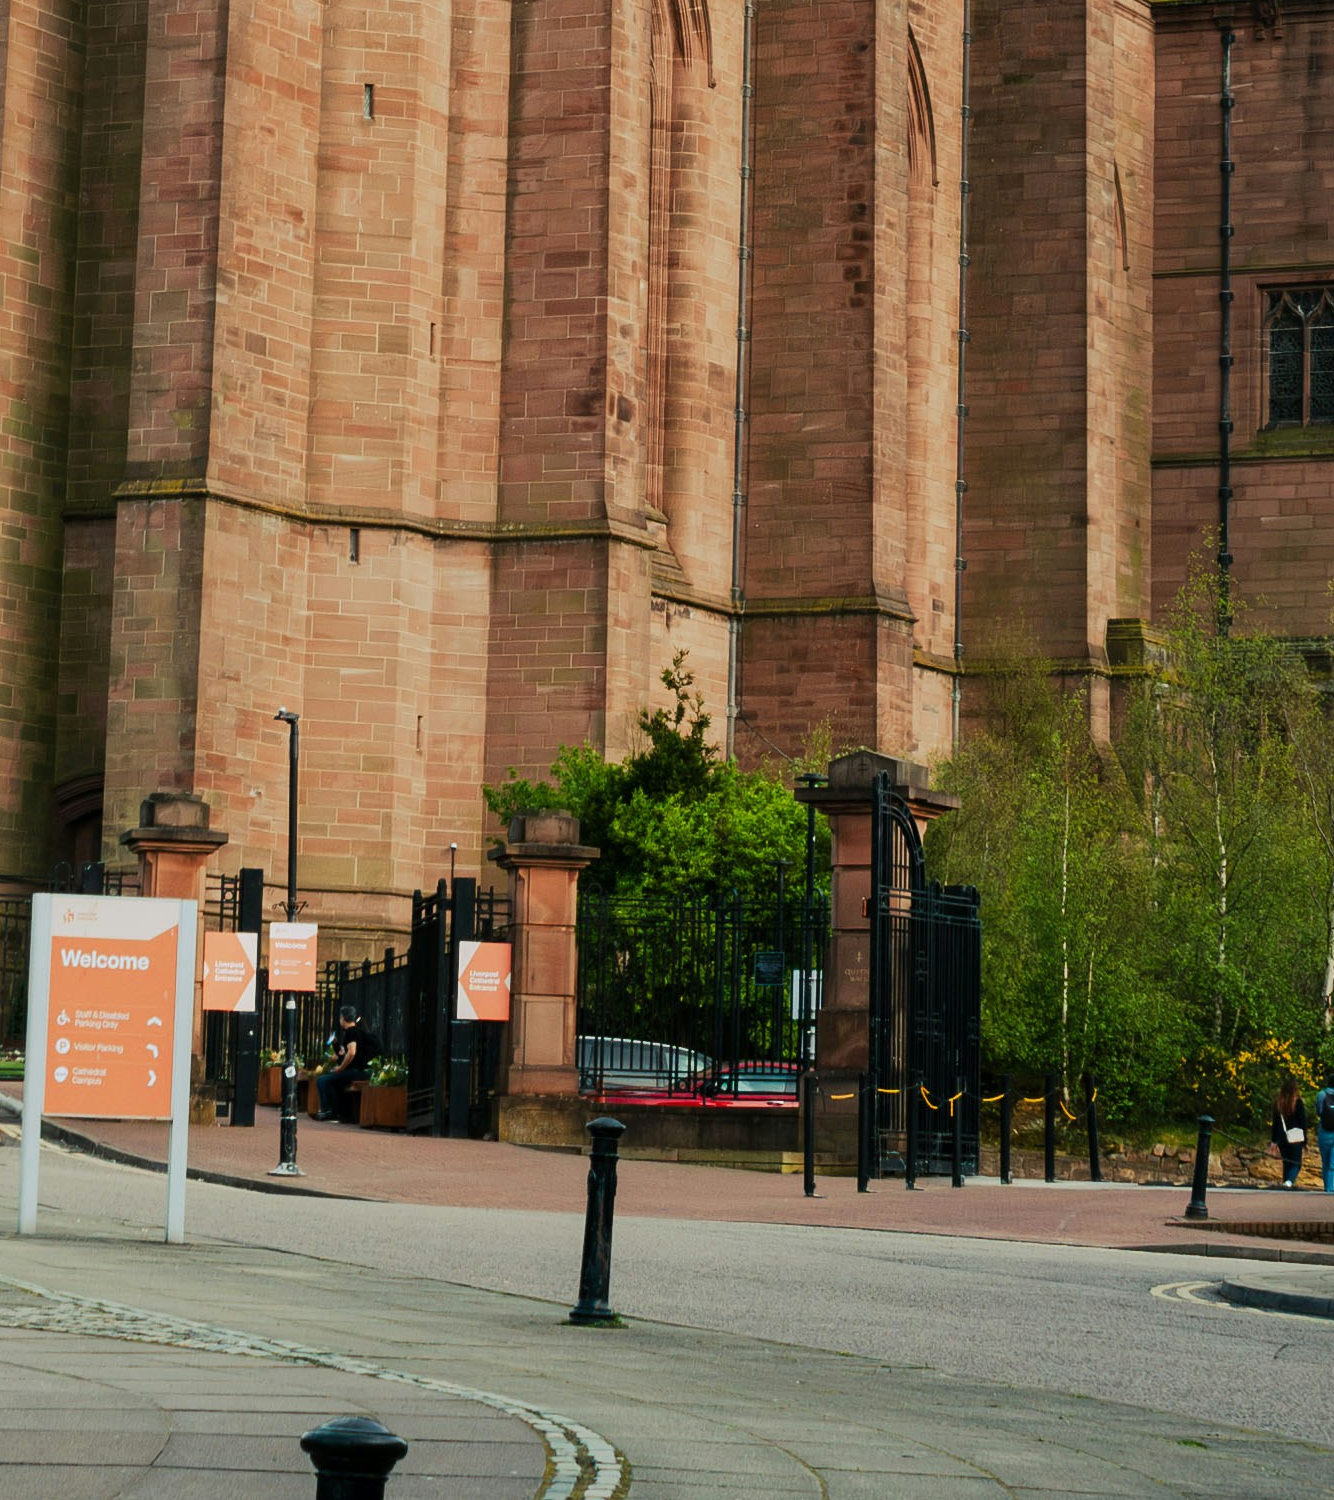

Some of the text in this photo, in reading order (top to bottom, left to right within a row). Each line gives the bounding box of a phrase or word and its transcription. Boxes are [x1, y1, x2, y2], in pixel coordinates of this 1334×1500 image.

[274, 941, 307, 950] Welcome
[60, 948, 150, 971] Welcome
[215, 960, 244, 969] Liverpool
[215, 968, 245, 976] Cathedral
[99, 1010, 130, 1021] Disabled
[75, 1019, 119, 1030] Parking Only
[96, 1043, 124, 1055] Parking
[72, 1067, 107, 1077] Cathedral
[71, 1076, 103, 1087] Campus
